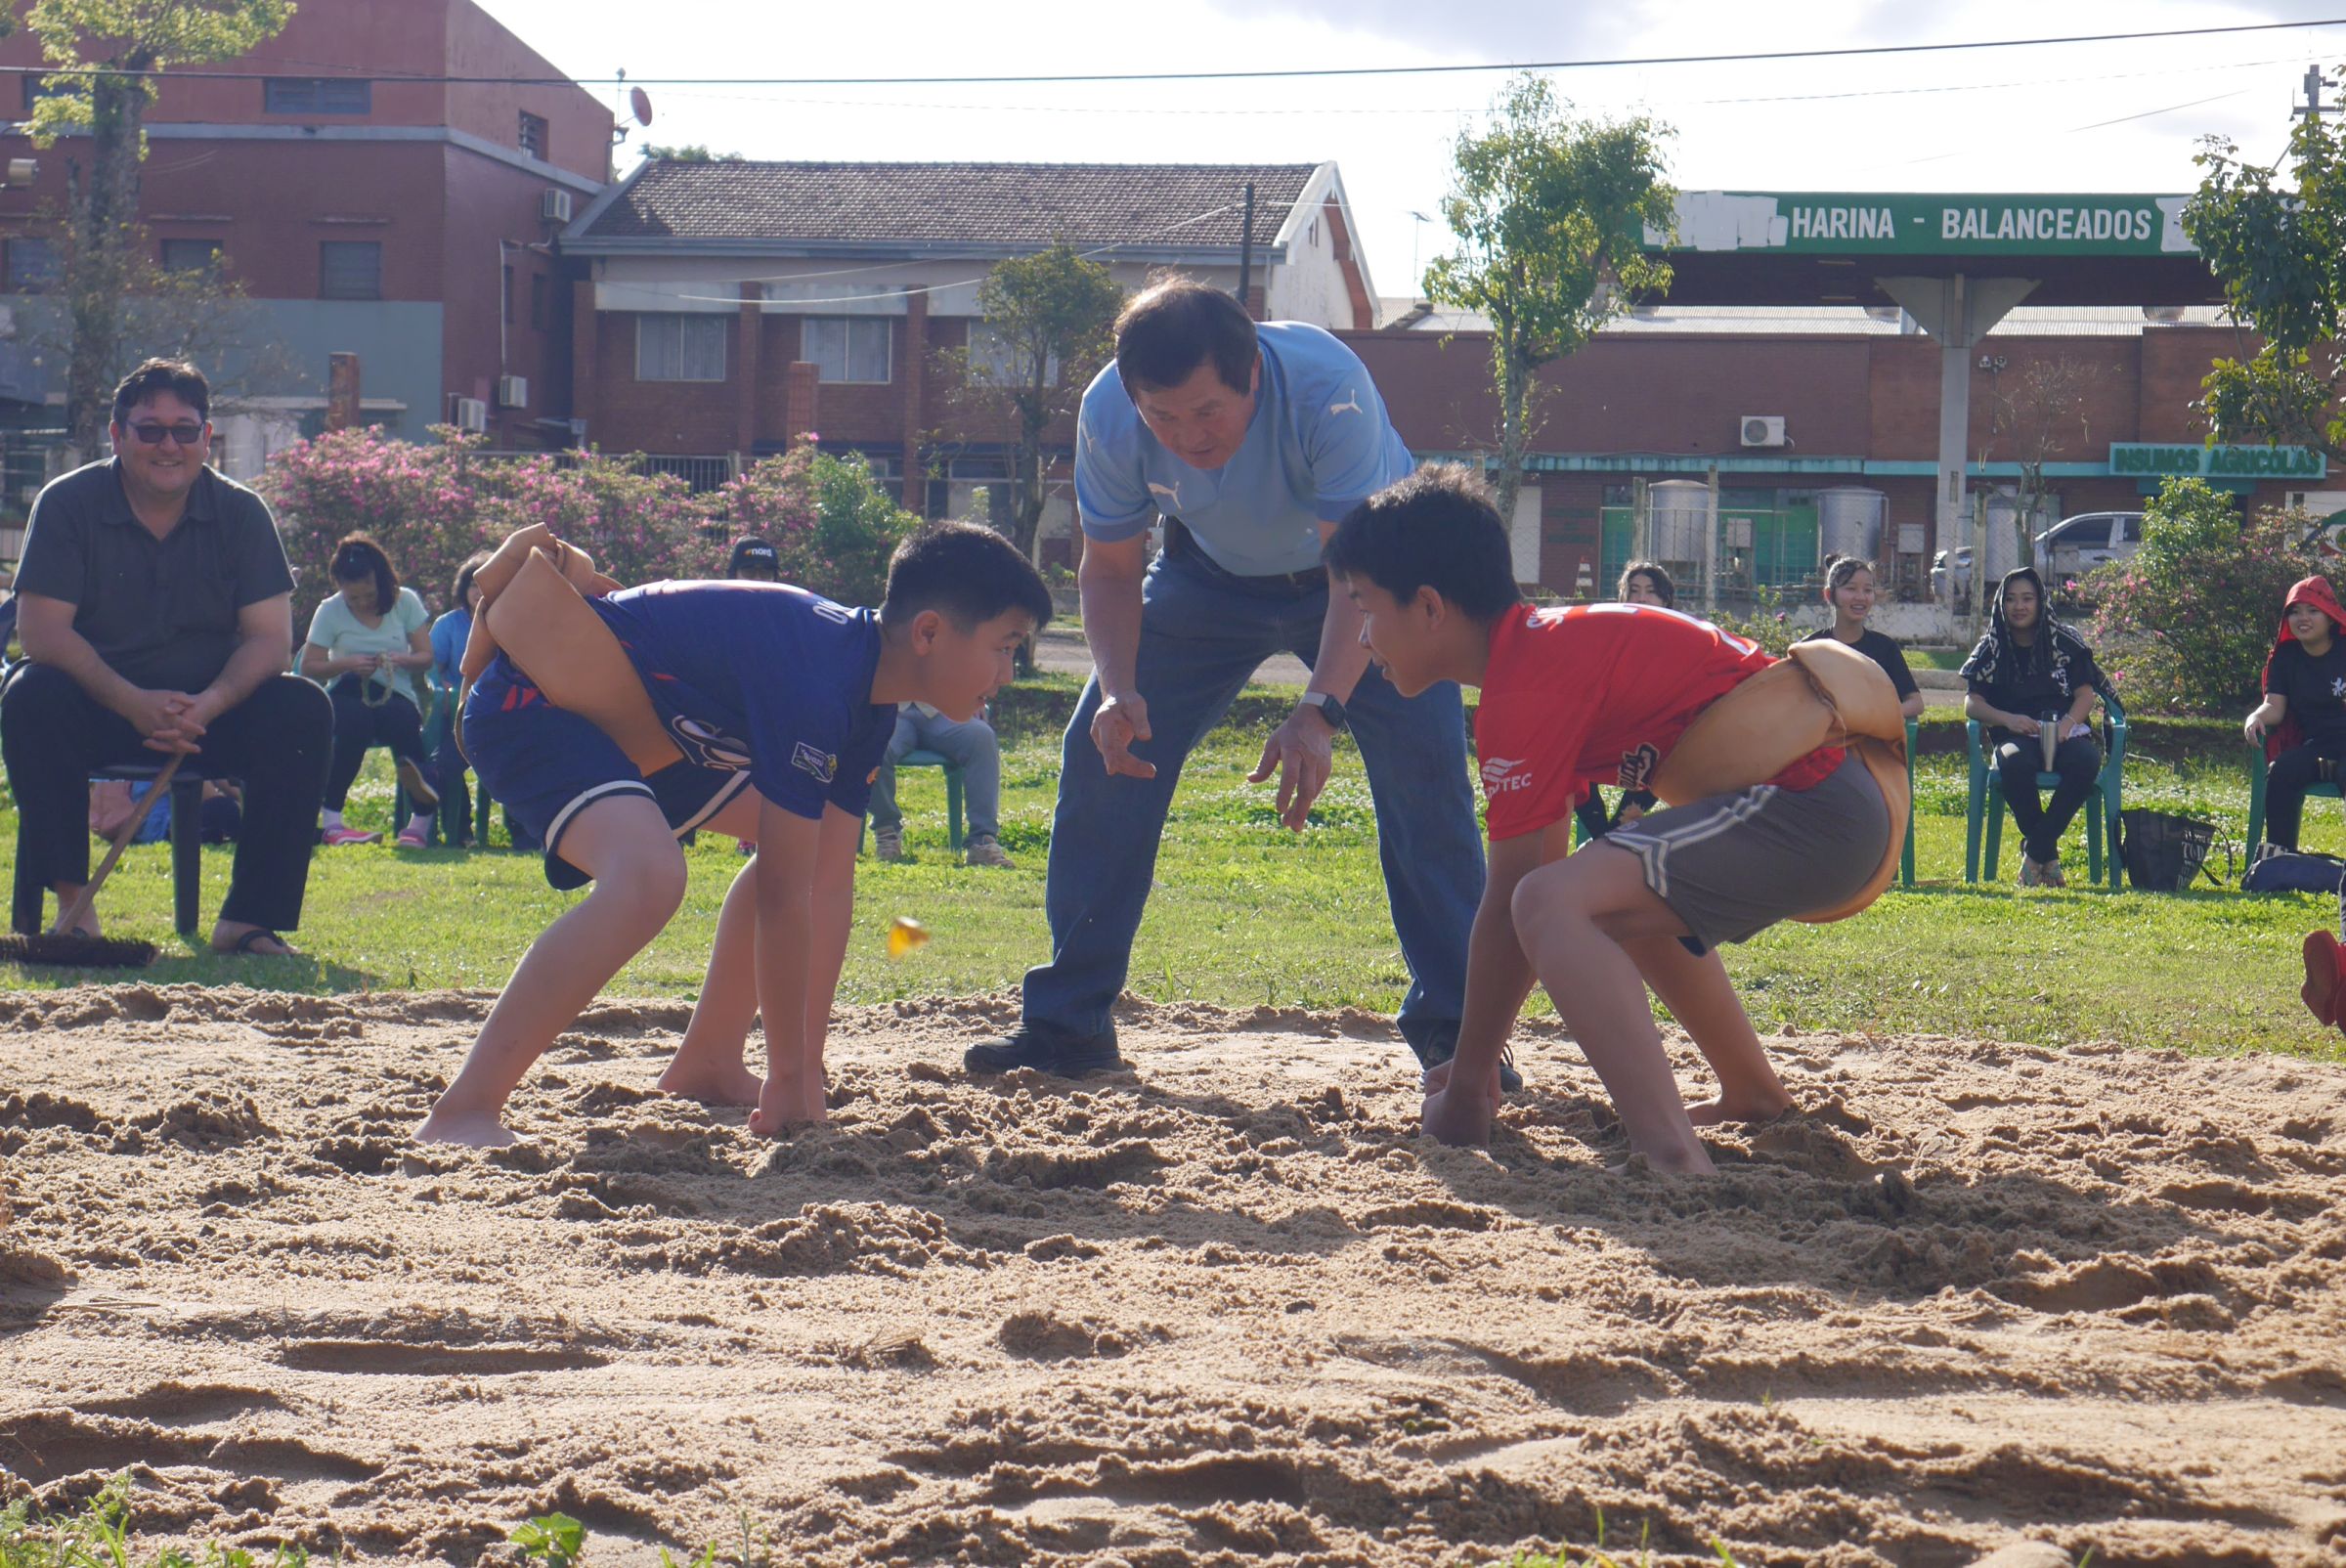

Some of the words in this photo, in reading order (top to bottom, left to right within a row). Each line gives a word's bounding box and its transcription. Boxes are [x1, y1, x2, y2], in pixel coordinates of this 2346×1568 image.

[1792, 206, 1895, 240] HARINA
[1941, 207, 2152, 240] BALANCEADOS
[2114, 448, 2199, 473] INSUMOS
